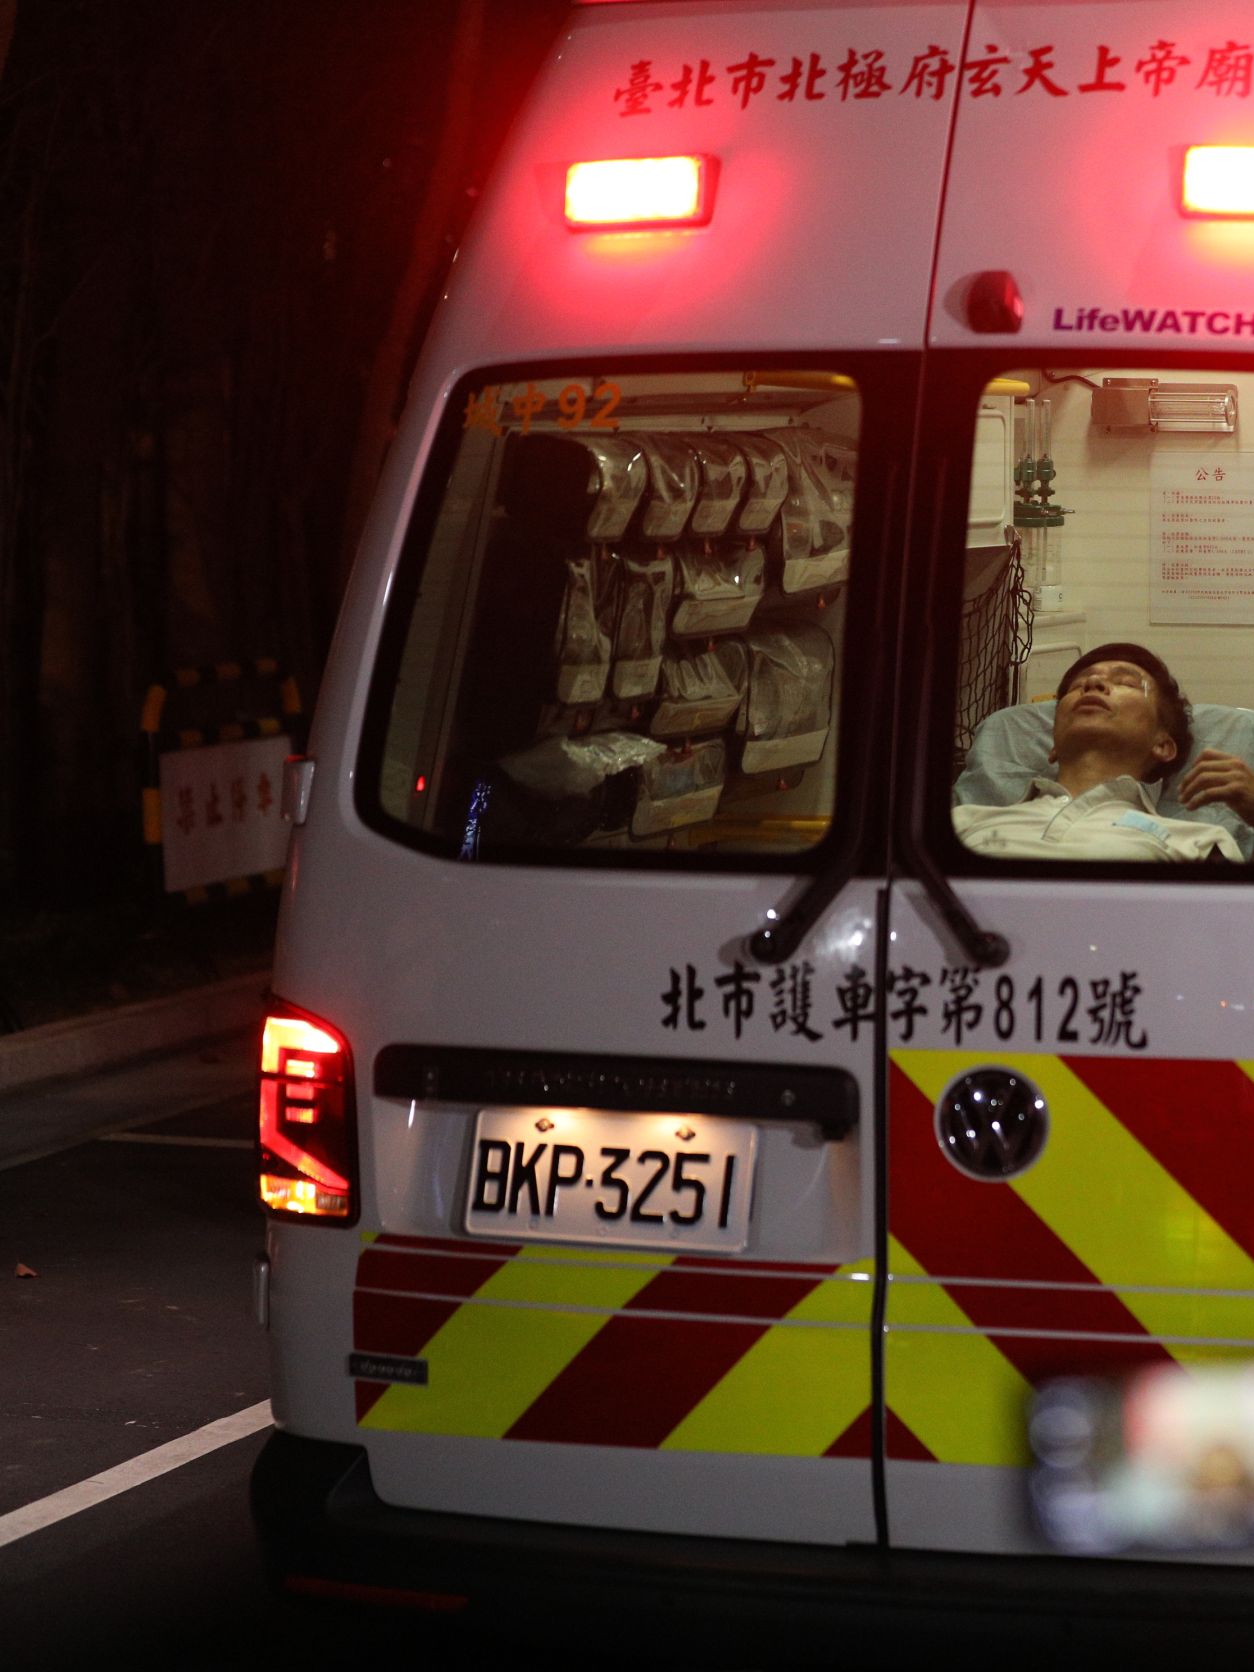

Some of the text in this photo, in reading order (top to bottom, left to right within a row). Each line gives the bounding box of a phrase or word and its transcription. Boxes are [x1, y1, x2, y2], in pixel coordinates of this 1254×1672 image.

[1195, 466, 1227, 482] 公告
[660, 960, 1148, 1050] 北市護車字第812號
